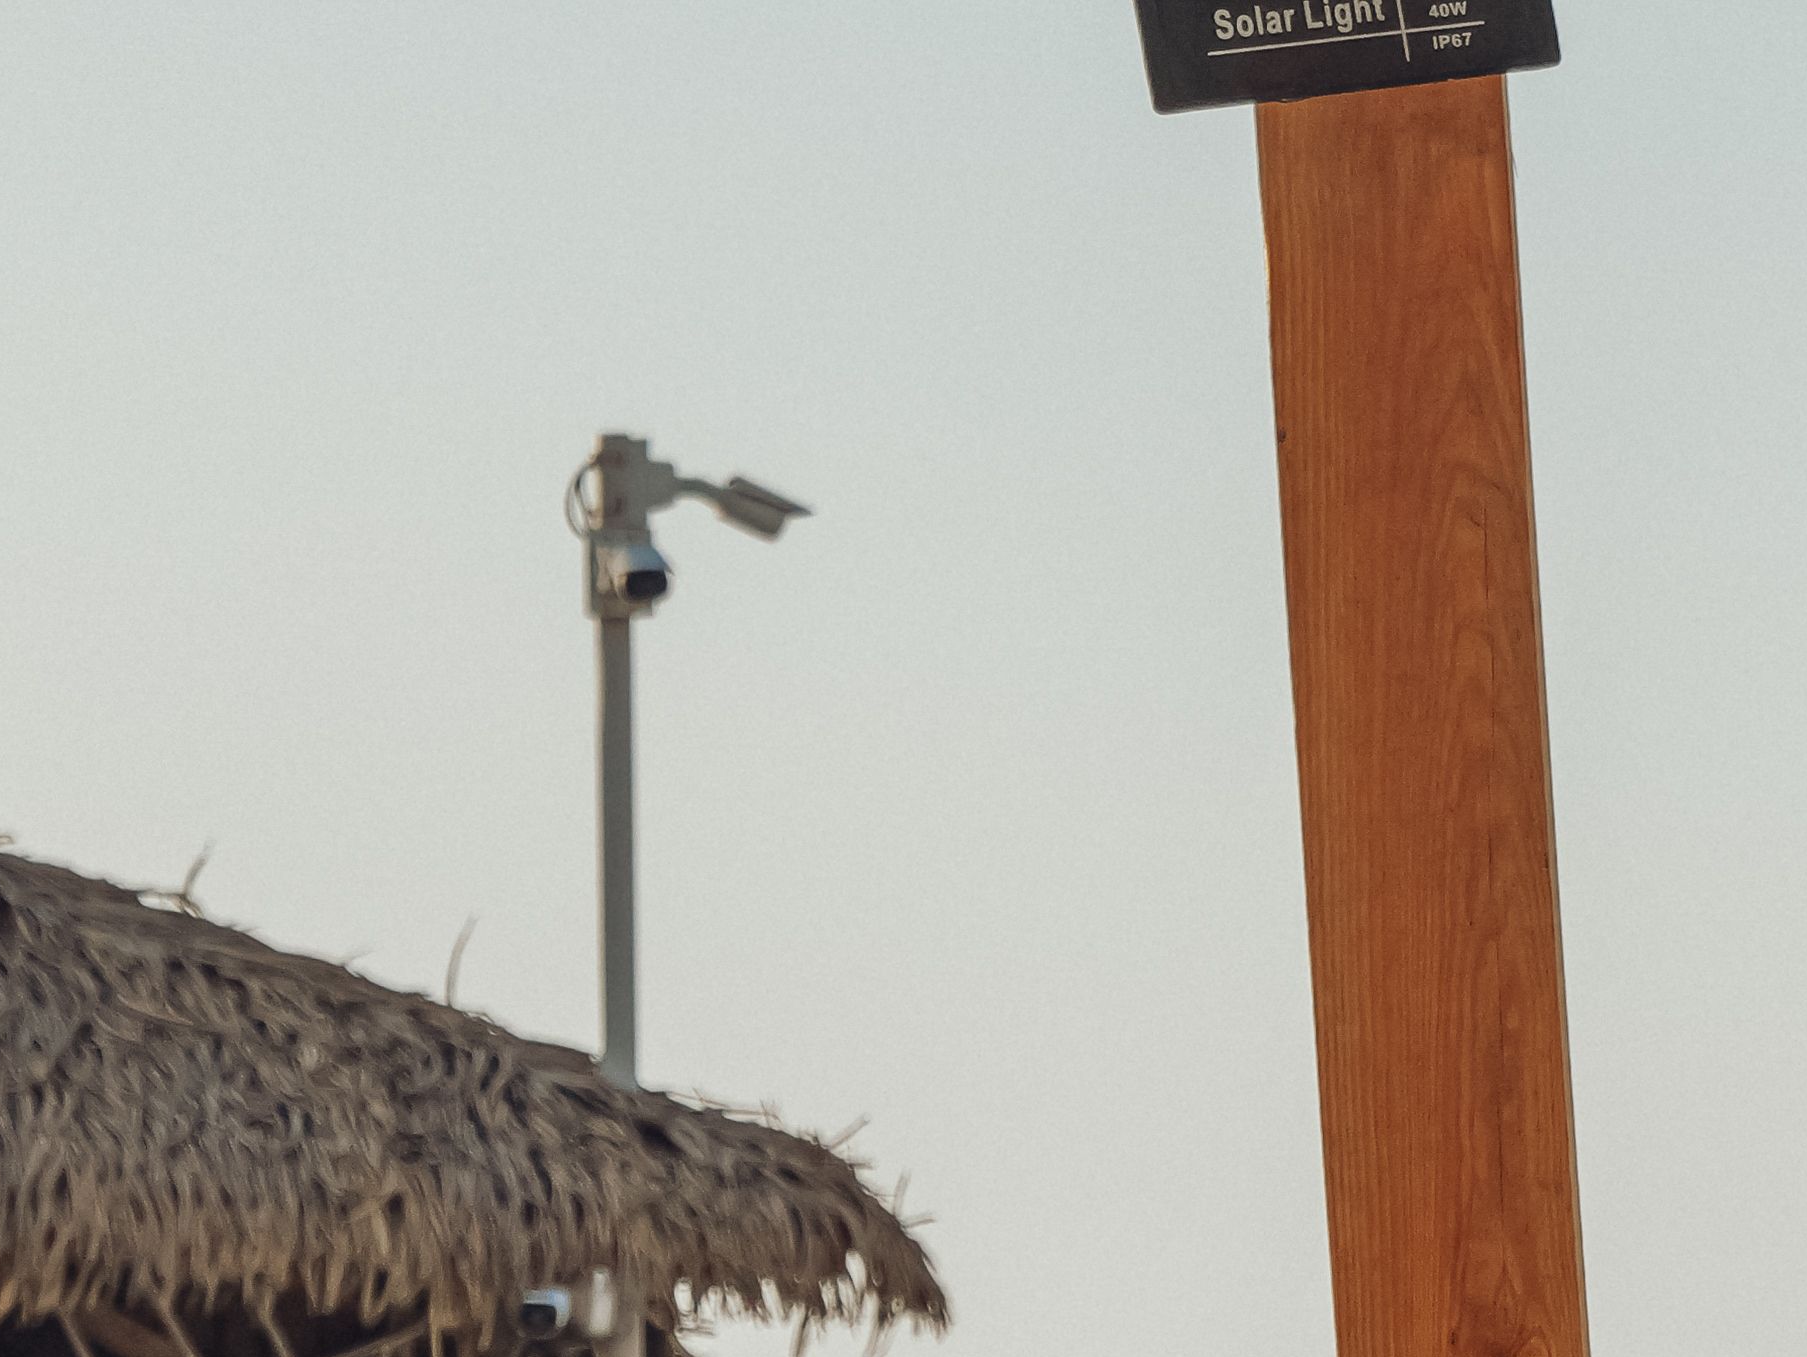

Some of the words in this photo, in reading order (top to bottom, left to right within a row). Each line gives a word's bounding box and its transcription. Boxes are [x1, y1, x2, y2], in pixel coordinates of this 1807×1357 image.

[1428, 0, 1469, 19] 40W
[1212, 4, 1295, 41] Solar
[1304, 0, 1387, 33] Light
[1431, 31, 1473, 51] IP67
